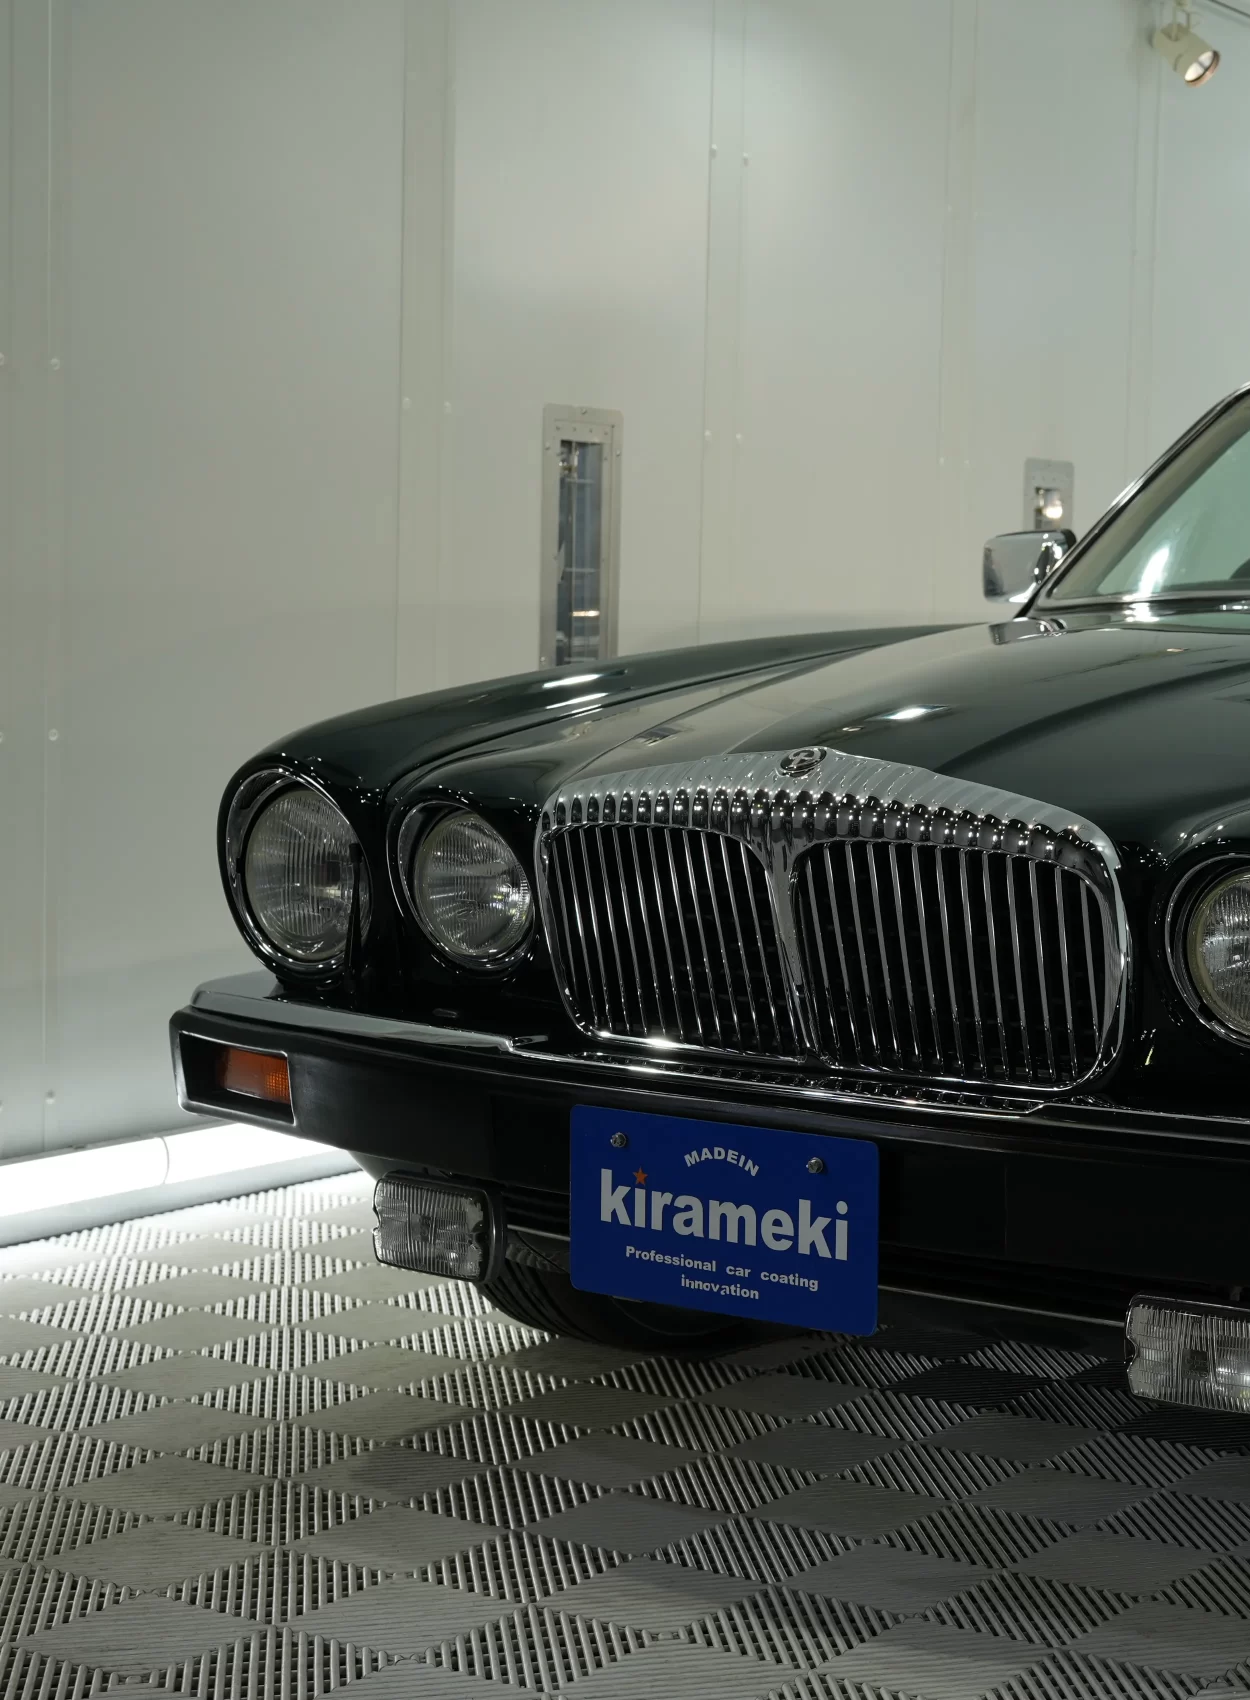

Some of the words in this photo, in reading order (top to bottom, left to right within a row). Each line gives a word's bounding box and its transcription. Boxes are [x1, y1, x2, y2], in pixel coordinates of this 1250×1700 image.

[600, 1167, 848, 1261] kirameki
[625, 1245, 717, 1272] Professional
[725, 1264, 751, 1278] car
[760, 1269, 819, 1292] coating
[680, 1274, 760, 1300] innovation
